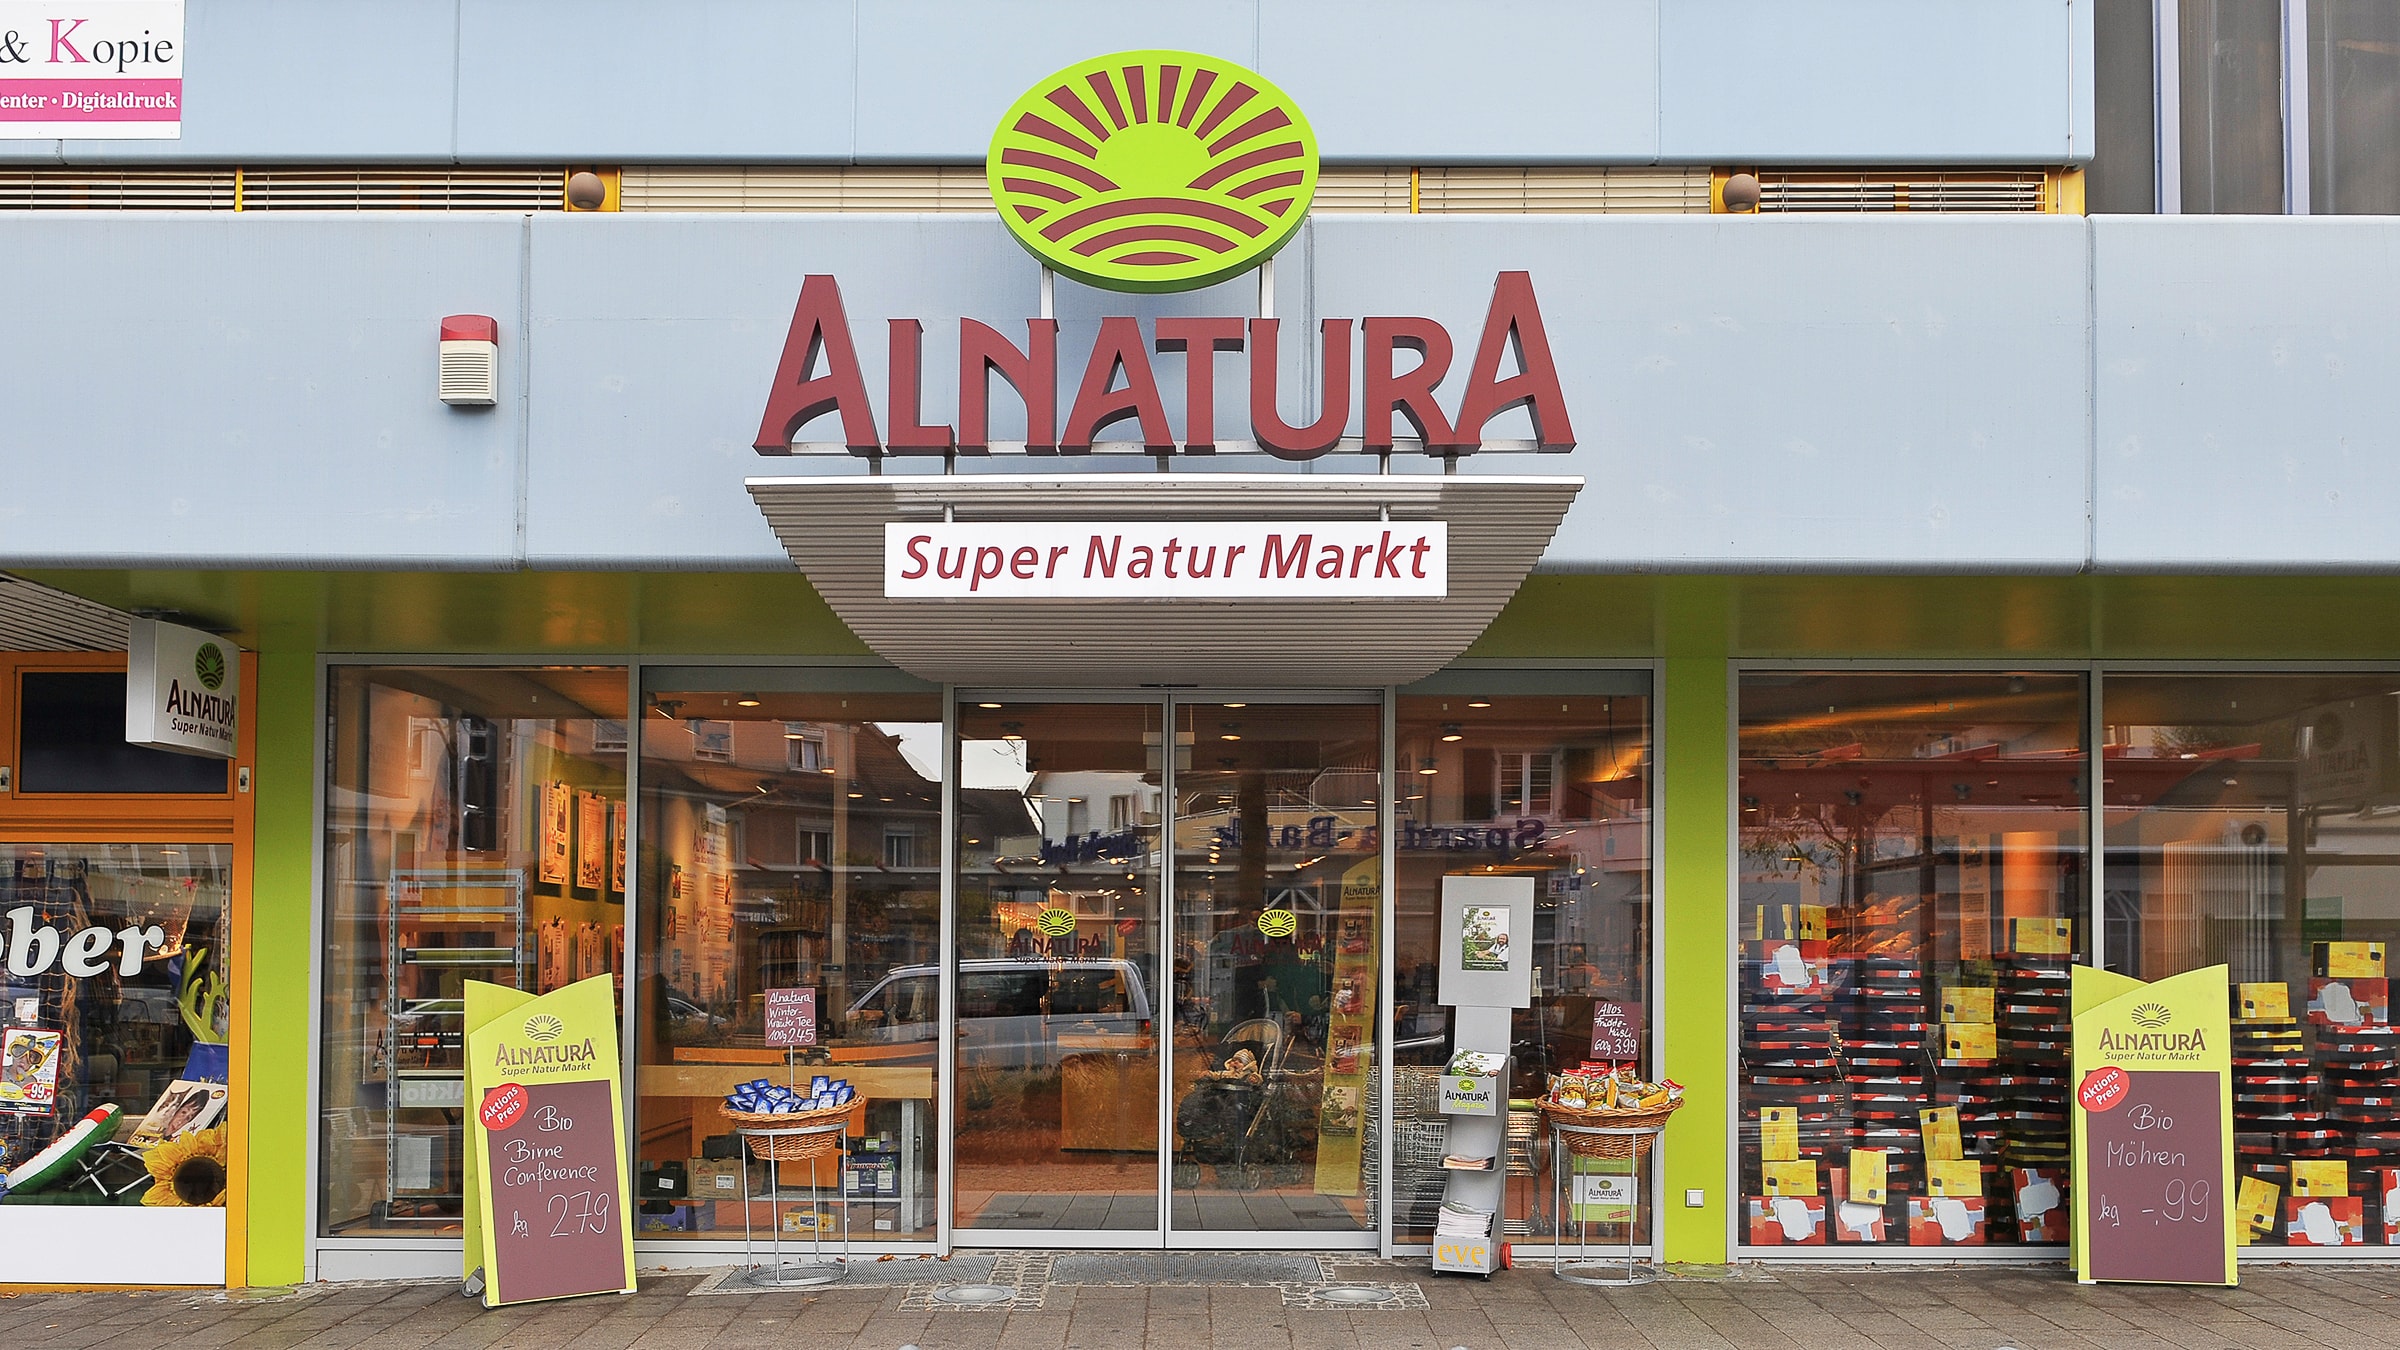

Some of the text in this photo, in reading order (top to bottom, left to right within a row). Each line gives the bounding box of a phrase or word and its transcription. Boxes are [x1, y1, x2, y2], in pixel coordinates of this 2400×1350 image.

[45, 18, 174, 74] Kopie
[0, 91, 177, 113] enter Digitaldruck
[752, 271, 1577, 461] ALNATURA
[901, 530, 1431, 592] Super Natur Markt
[166, 678, 237, 729] ALNATURA
[171, 717, 198, 735] Super
[0, 905, 165, 979] ber
[768, 990, 813, 1005] Alnatura
[1597, 1003, 1625, 1016] Allos
[796, 1016, 815, 1027] Tee
[787, 1027, 816, 1043] 2.45
[1613, 1038, 1637, 1055] 3.99
[2098, 1028, 2207, 1051] ALNATURA
[495, 1038, 597, 1067] ALNATURA
[2104, 1052, 2201, 1062] Super Natur Markt
[500, 1063, 591, 1077] Super Natur Markt
[1445, 1090, 1489, 1101] ALNATURA
[2082, 1069, 2120, 1103] Aktions
[2095, 1082, 2121, 1106] Preis
[484, 1086, 519, 1122] Aktions
[496, 1099, 521, 1124] Preis
[2127, 1103, 2174, 1131] Bio
[503, 1139, 564, 1163] Birne
[2107, 1140, 2186, 1169] Möhren
[503, 1161, 598, 1192] Conference
[1588, 1188, 1623, 1197] ALNATURA
[510, 1190, 610, 1239] kg 2.79
[2098, 1194, 2120, 1228] kg
[1438, 1244, 1486, 1266] eve
